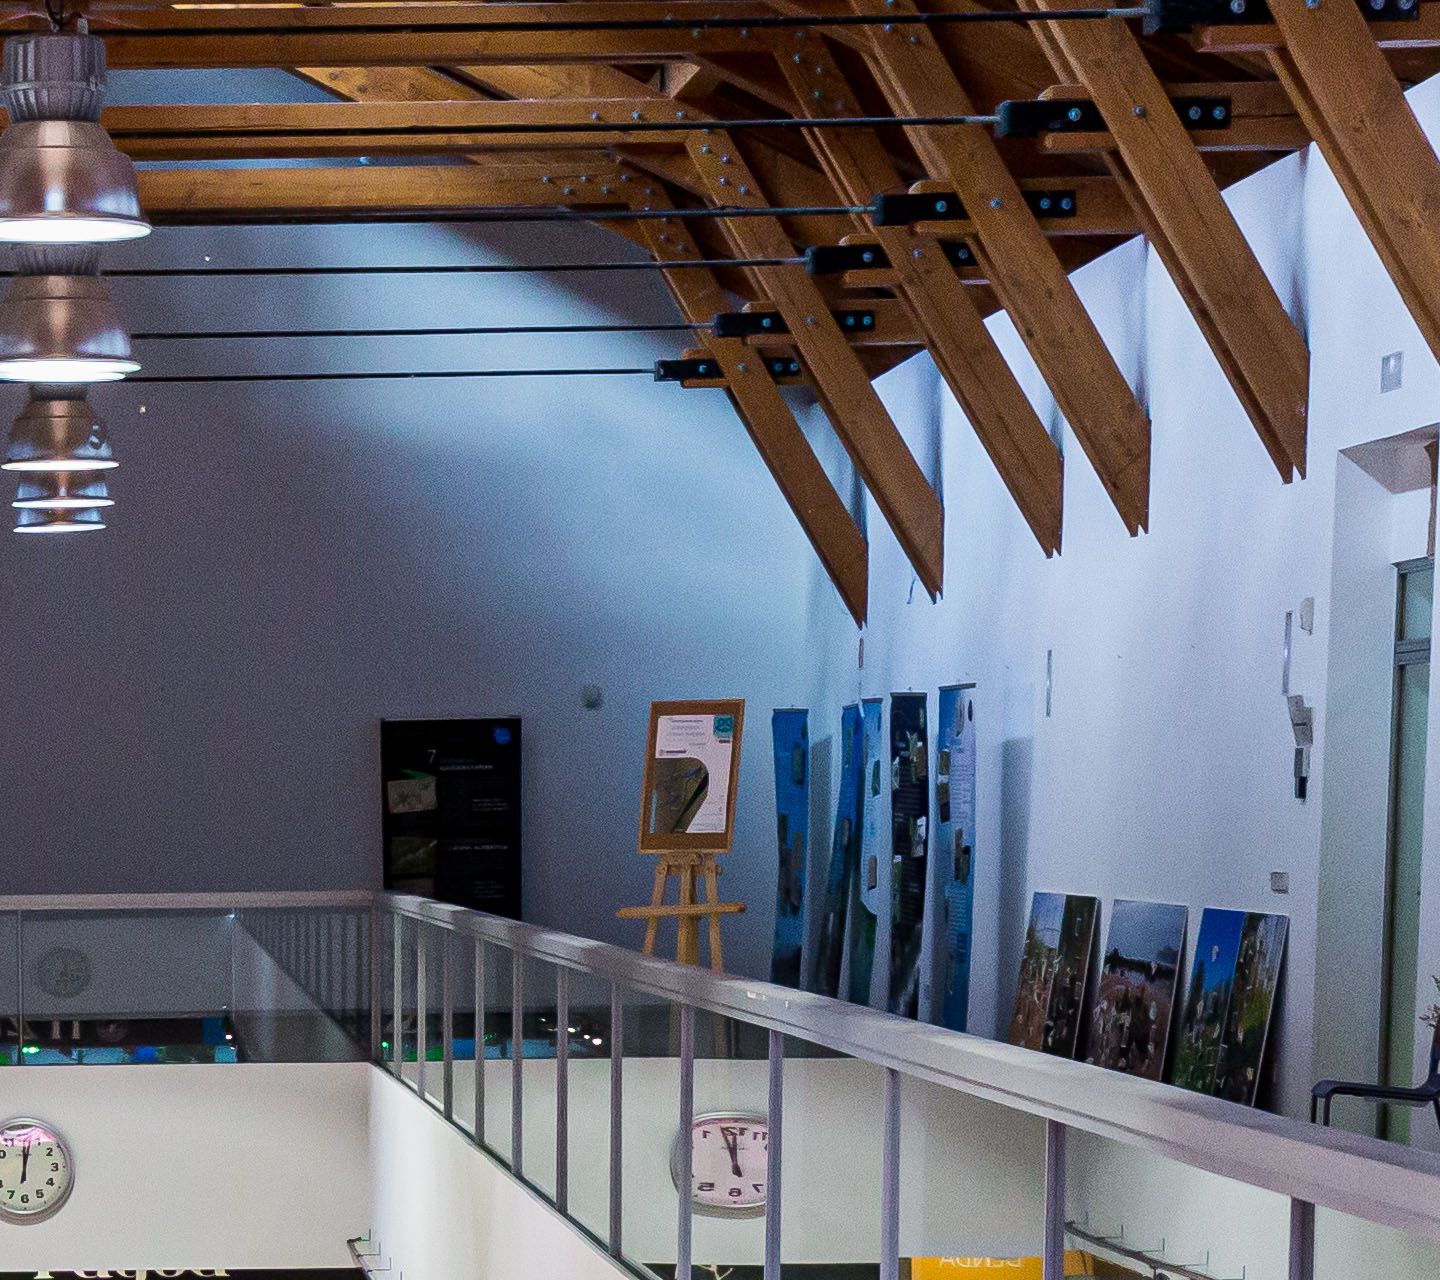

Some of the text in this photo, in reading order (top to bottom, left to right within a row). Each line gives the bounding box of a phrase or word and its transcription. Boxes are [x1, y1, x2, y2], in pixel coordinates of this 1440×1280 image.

[46, 1147, 53, 1157] 2
[50, 1162, 59, 1172] 3
[46, 1177, 55, 1187] 4
[7, 1190, 15, 1199] 7
[36, 1189, 44, 1198] 5
[20, 1194, 29, 1204] 6
